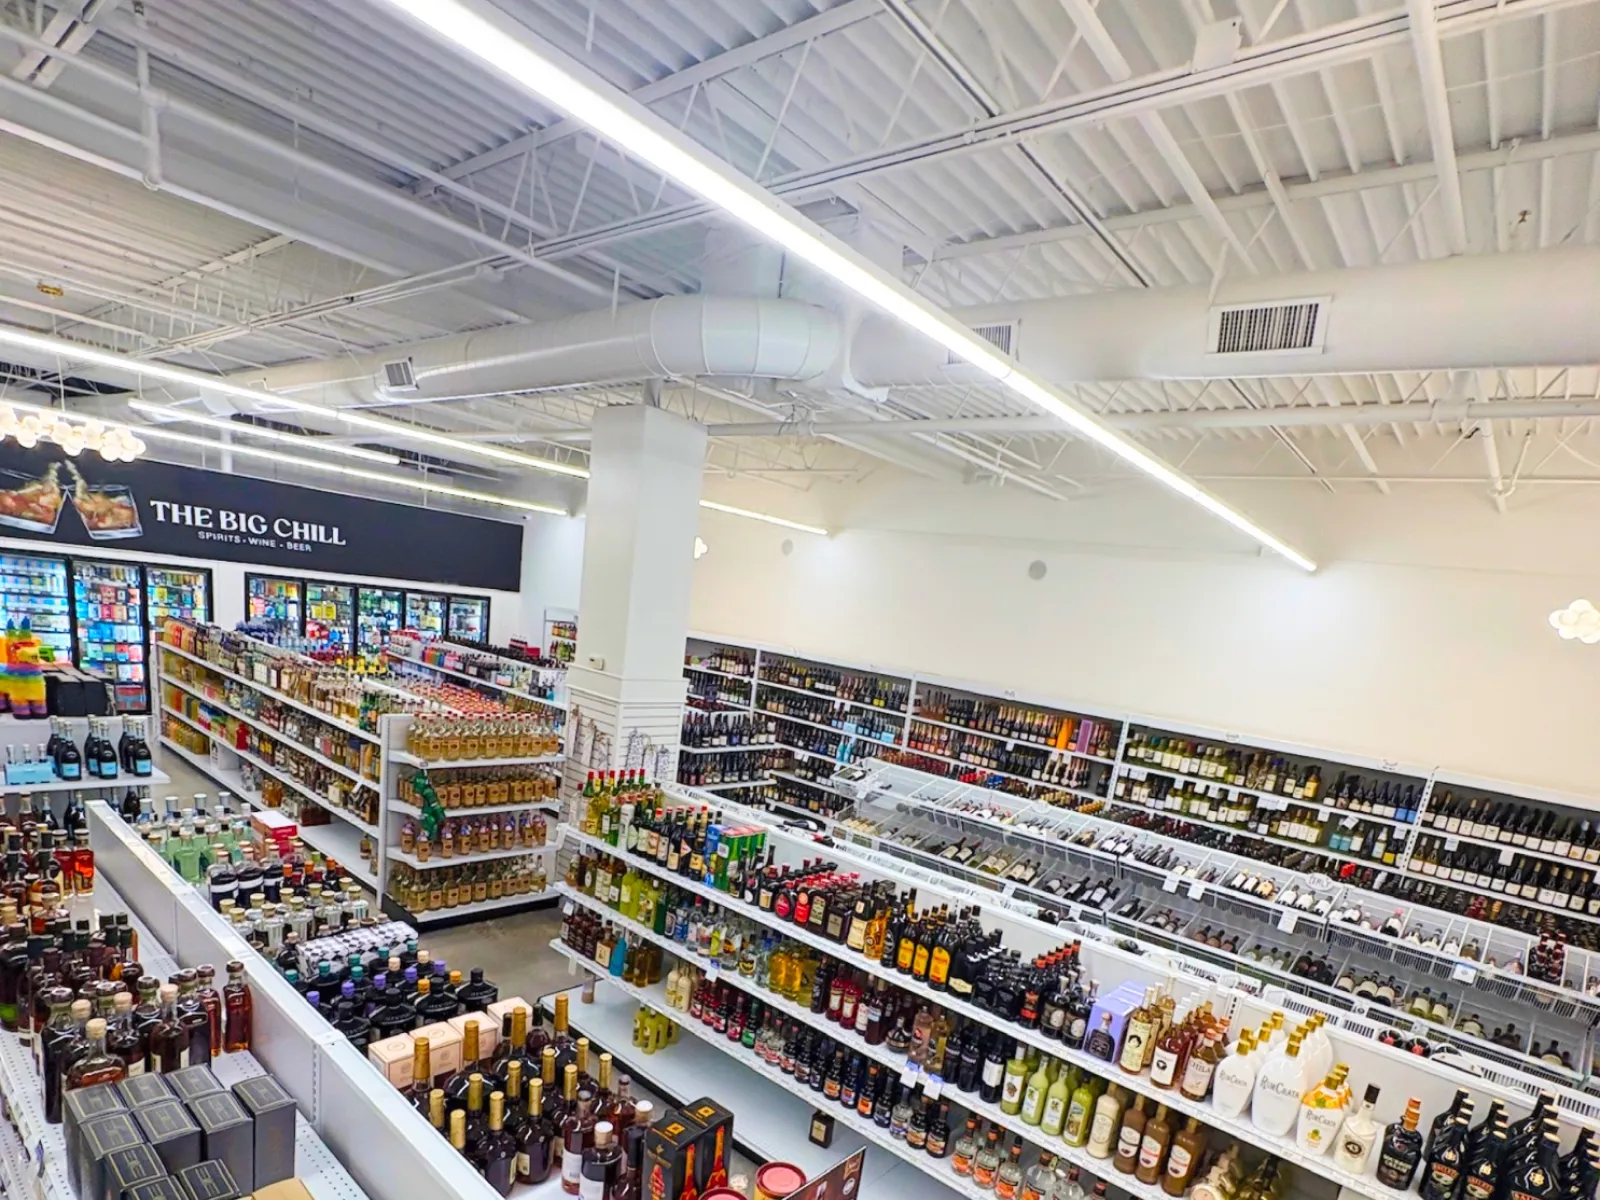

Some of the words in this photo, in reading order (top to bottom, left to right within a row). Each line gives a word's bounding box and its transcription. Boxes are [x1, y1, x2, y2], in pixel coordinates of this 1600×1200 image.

[150, 500, 213, 528] THE
[219, 510, 268, 534] BIG
[273, 518, 347, 545] CHILL
[198, 531, 241, 543] SPIRITS
[248, 537, 276, 548] WINE
[286, 541, 312, 552] BEER
